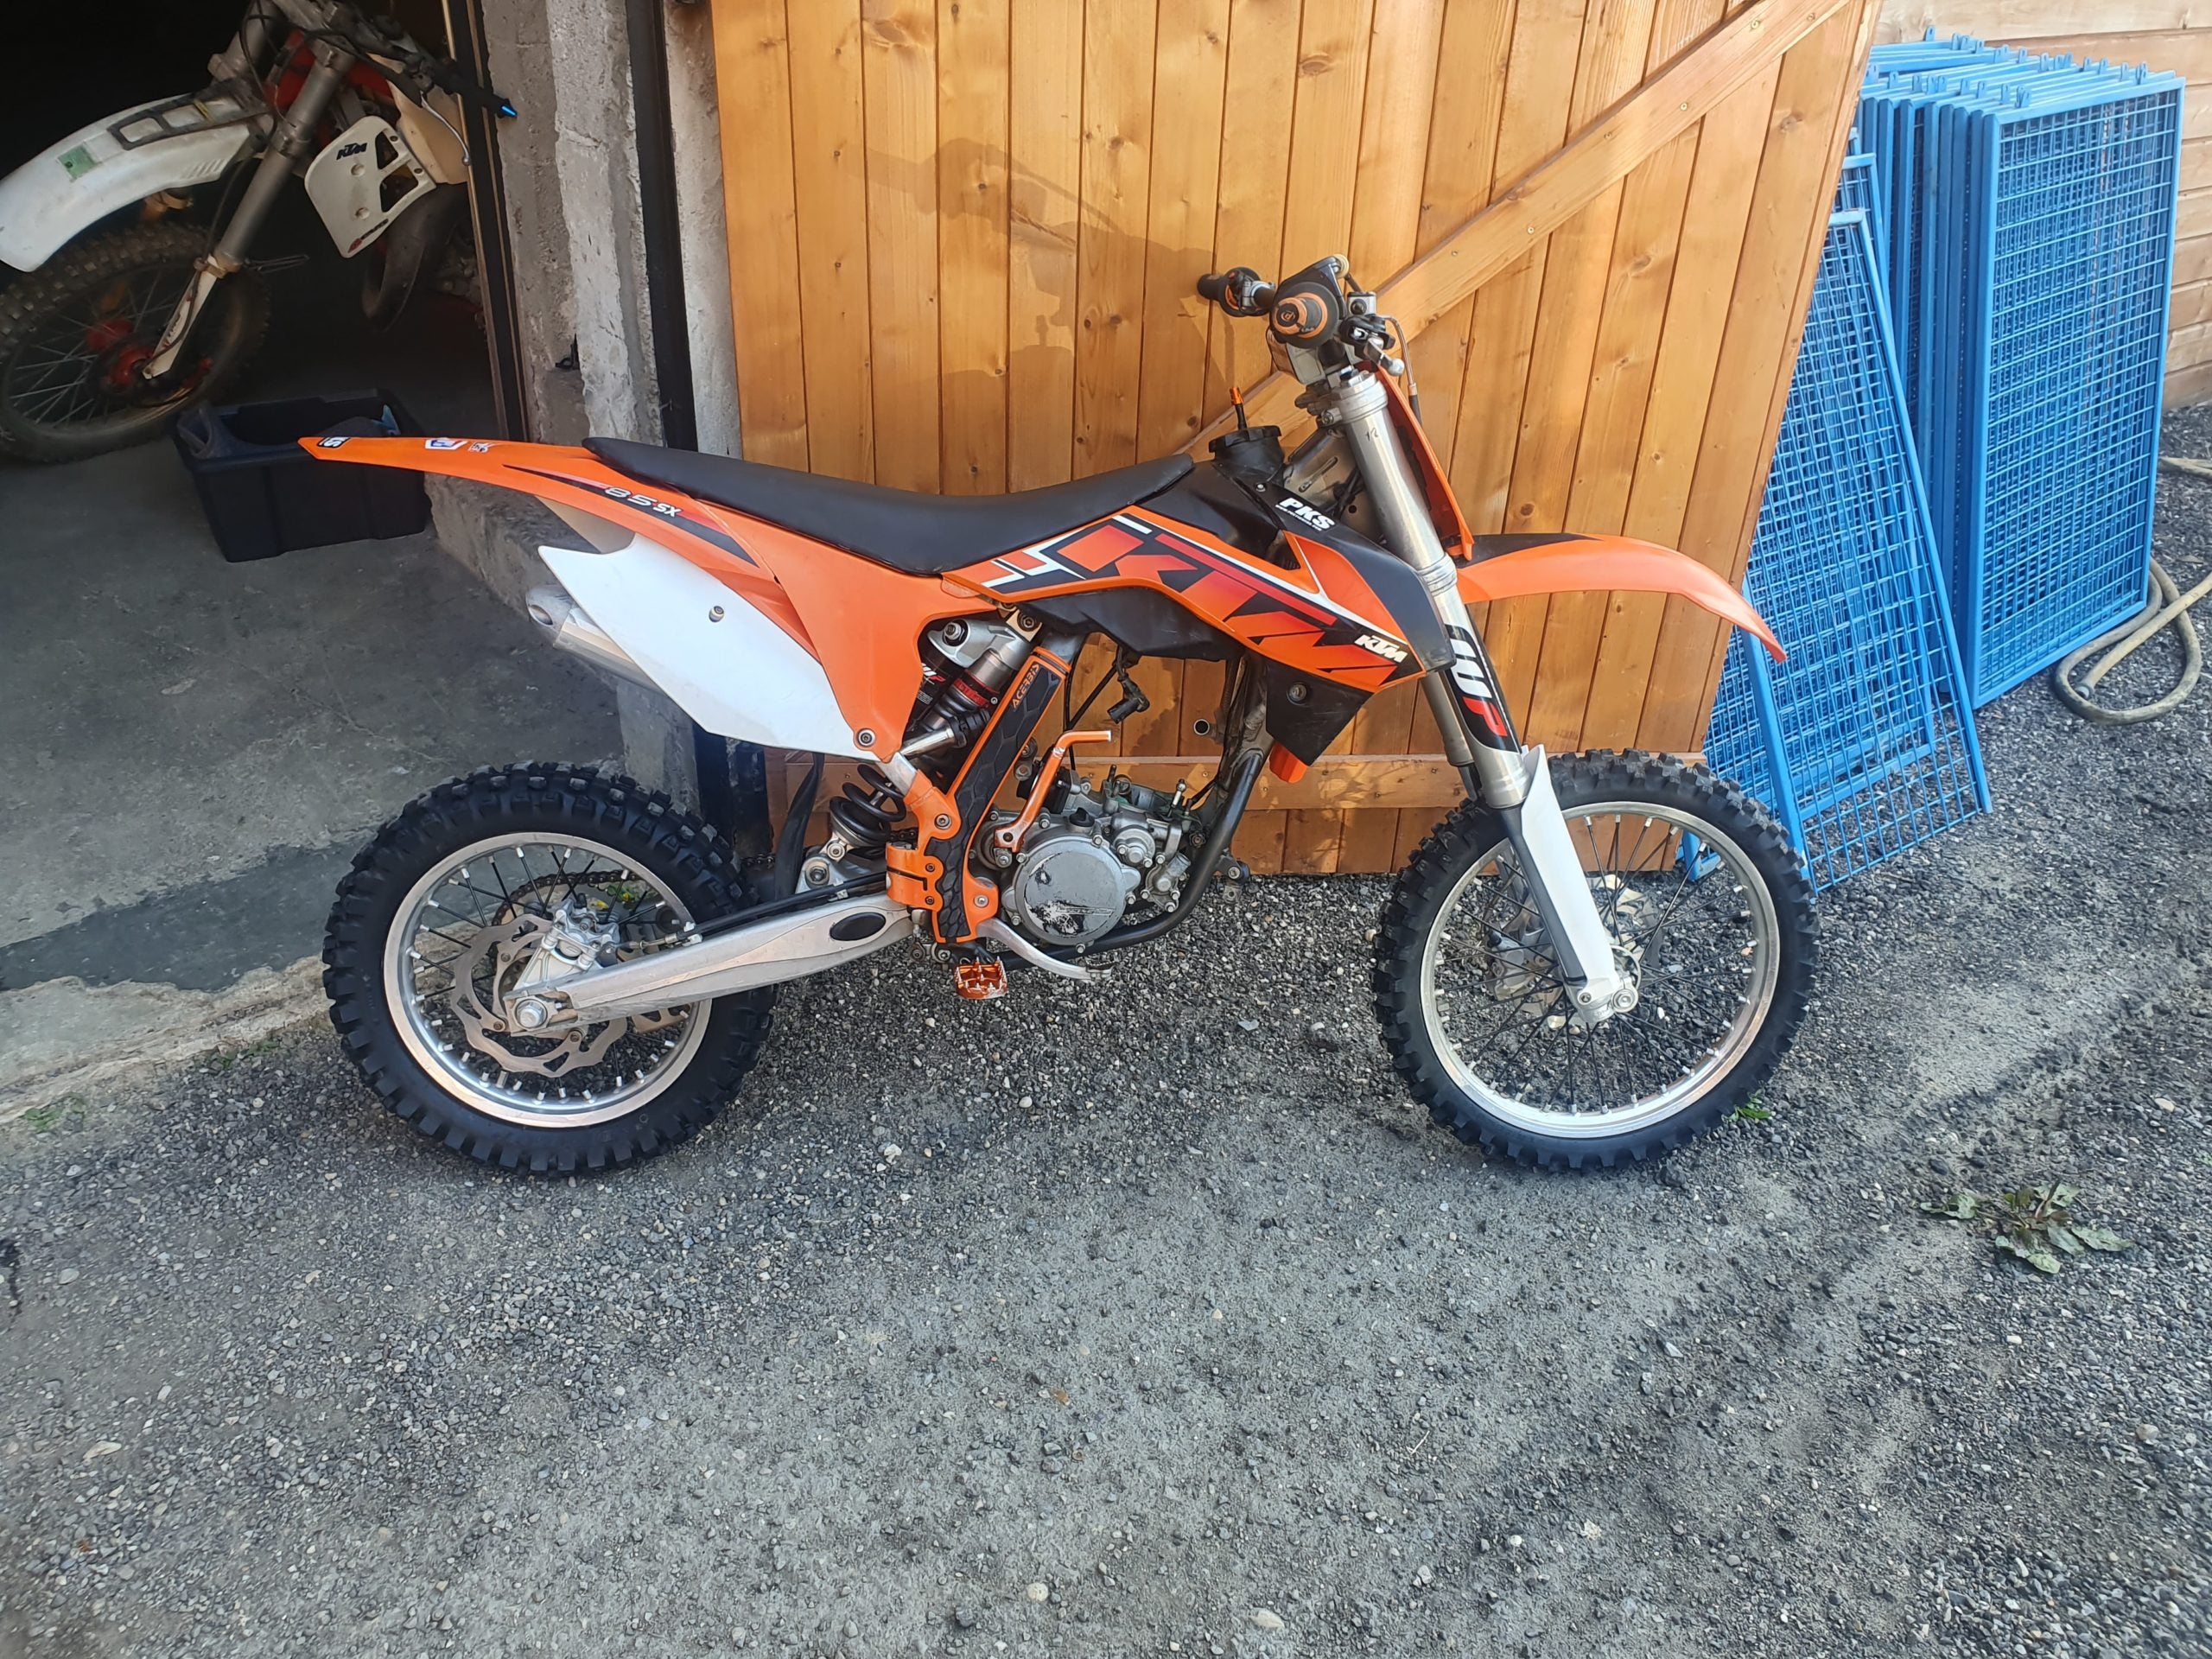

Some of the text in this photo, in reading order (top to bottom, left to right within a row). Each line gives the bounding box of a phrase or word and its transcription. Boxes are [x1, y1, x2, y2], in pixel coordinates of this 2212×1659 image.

[336, 143, 367, 160] KTM
[604, 486, 682, 518] 85 SX
[1279, 497, 1336, 530] PKS
[1354, 634, 1408, 663] KTM
